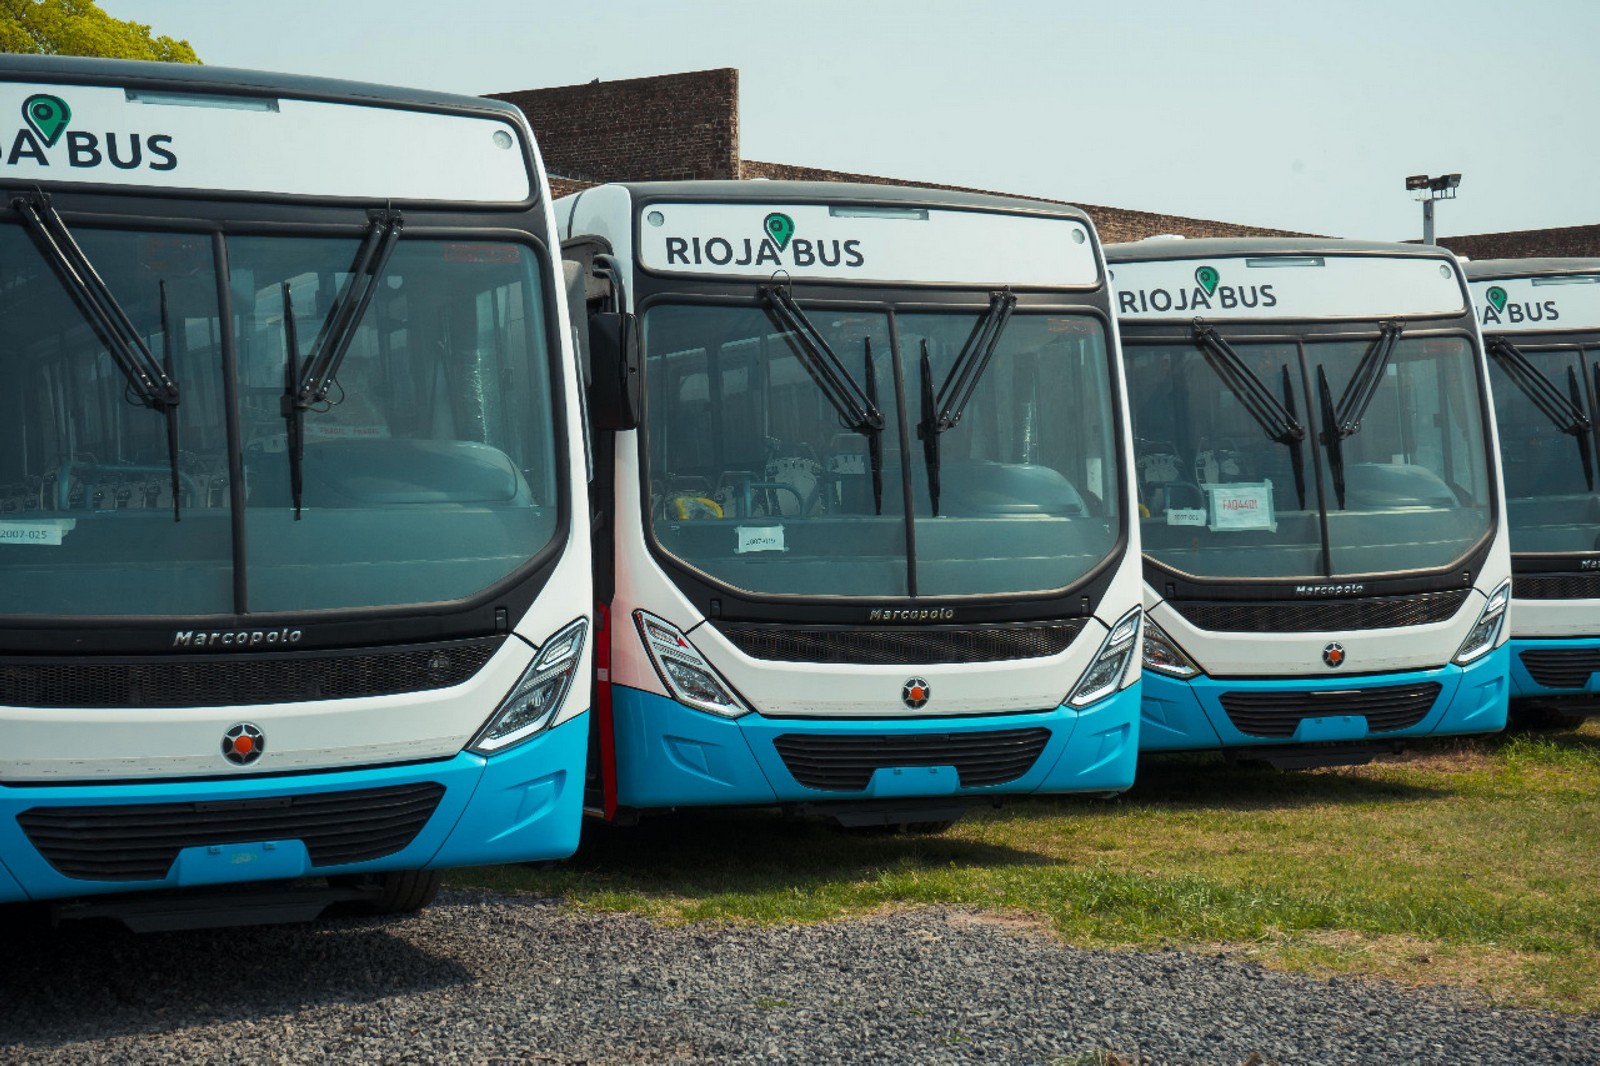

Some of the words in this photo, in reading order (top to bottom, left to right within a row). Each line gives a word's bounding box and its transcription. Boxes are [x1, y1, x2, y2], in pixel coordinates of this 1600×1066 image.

[0, 129, 49, 166] A
[66, 131, 178, 171] BUS
[666, 237, 782, 266] RIOJA
[792, 239, 865, 267] BUS
[1118, 287, 1211, 313] RIOJA
[1219, 284, 1277, 309] BUS
[1507, 301, 1559, 323] BUS
[0, 530, 48, 539] 2007-025
[1295, 584, 1363, 595] Marcopolo
[869, 608, 954, 620] Marcopolo
[173, 628, 302, 646] Marcopolo
